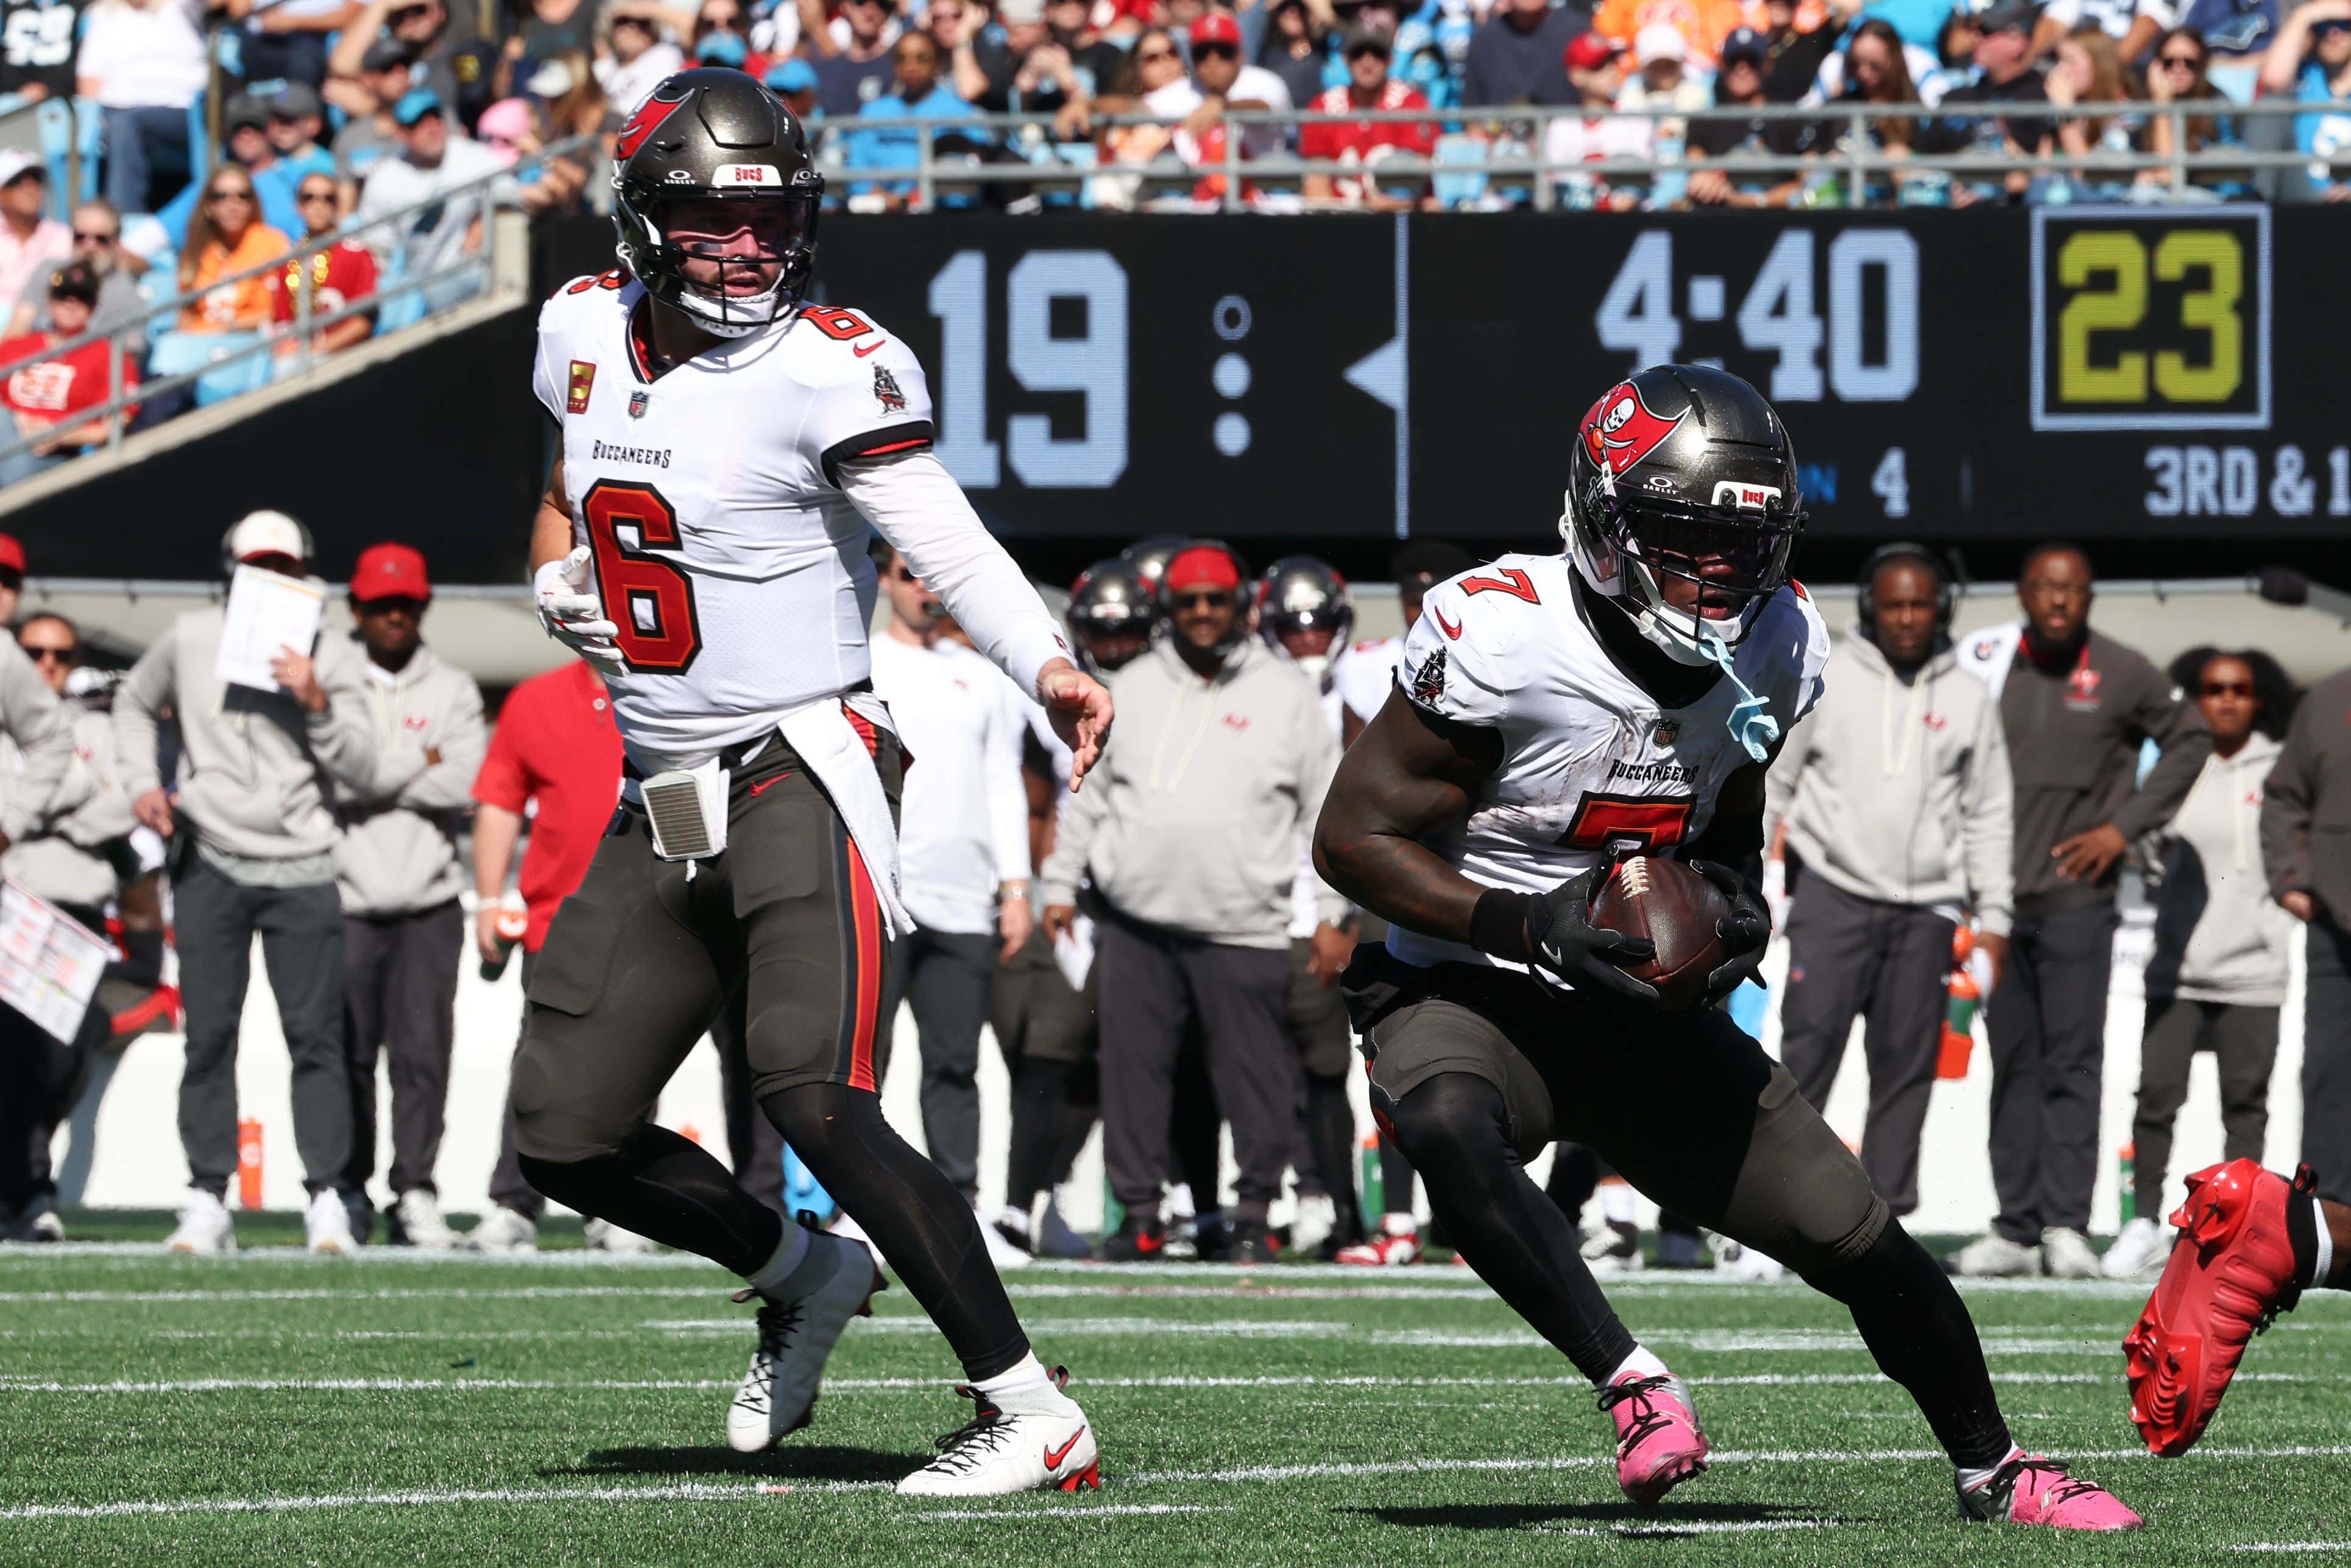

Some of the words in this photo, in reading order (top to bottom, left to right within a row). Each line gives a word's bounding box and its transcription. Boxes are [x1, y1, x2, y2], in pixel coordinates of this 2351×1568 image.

[735, 167, 762, 182] BUCS
[795, 306, 874, 341] 6
[1594, 227, 1921, 403] 4:40
[2058, 228, 2244, 403] 23
[927, 248, 1130, 490] 19
[1643, 484, 1678, 495] OAKLEY
[1871, 446, 1910, 518] 4
[2143, 444, 2259, 517] 3RD
[2269, 443, 2316, 517] &
[581, 477, 703, 677] 6
[1457, 567, 1541, 606] 7
[1607, 758, 1700, 786] BUCCANEERS
